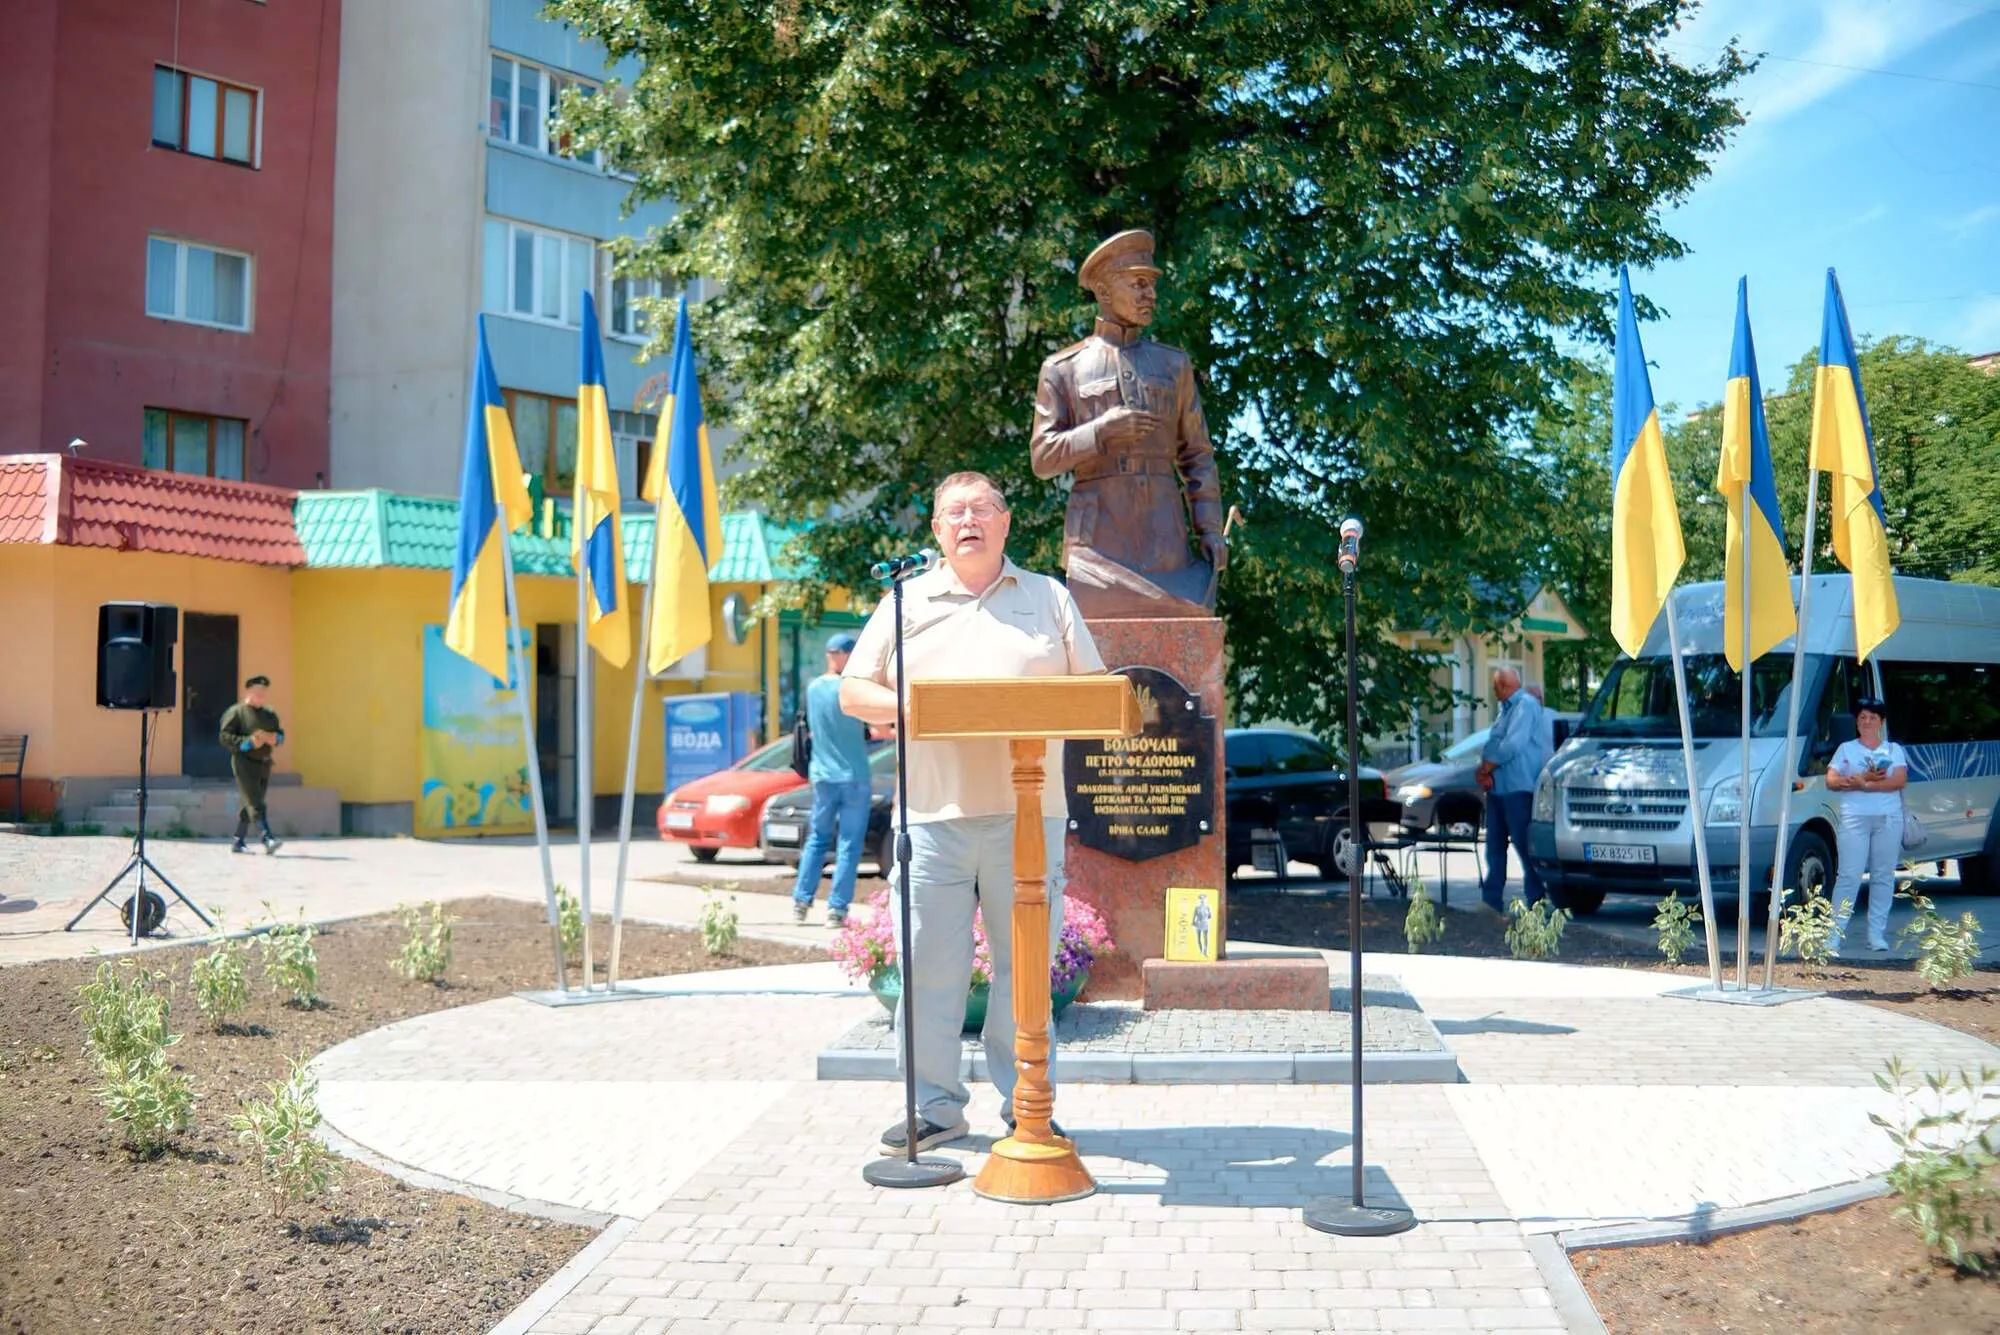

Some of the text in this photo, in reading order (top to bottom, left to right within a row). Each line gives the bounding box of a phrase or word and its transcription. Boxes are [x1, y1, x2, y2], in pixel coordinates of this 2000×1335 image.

[671, 731, 722, 749] ВОДА
[1103, 738, 1178, 752] БОЛБОЧАН
[1085, 755, 1196, 768] ПЕТРО ФЕДОРОВИЧ
[1133, 795, 1144, 804] ТА
[1136, 825, 1169, 835] СЛАВА!
